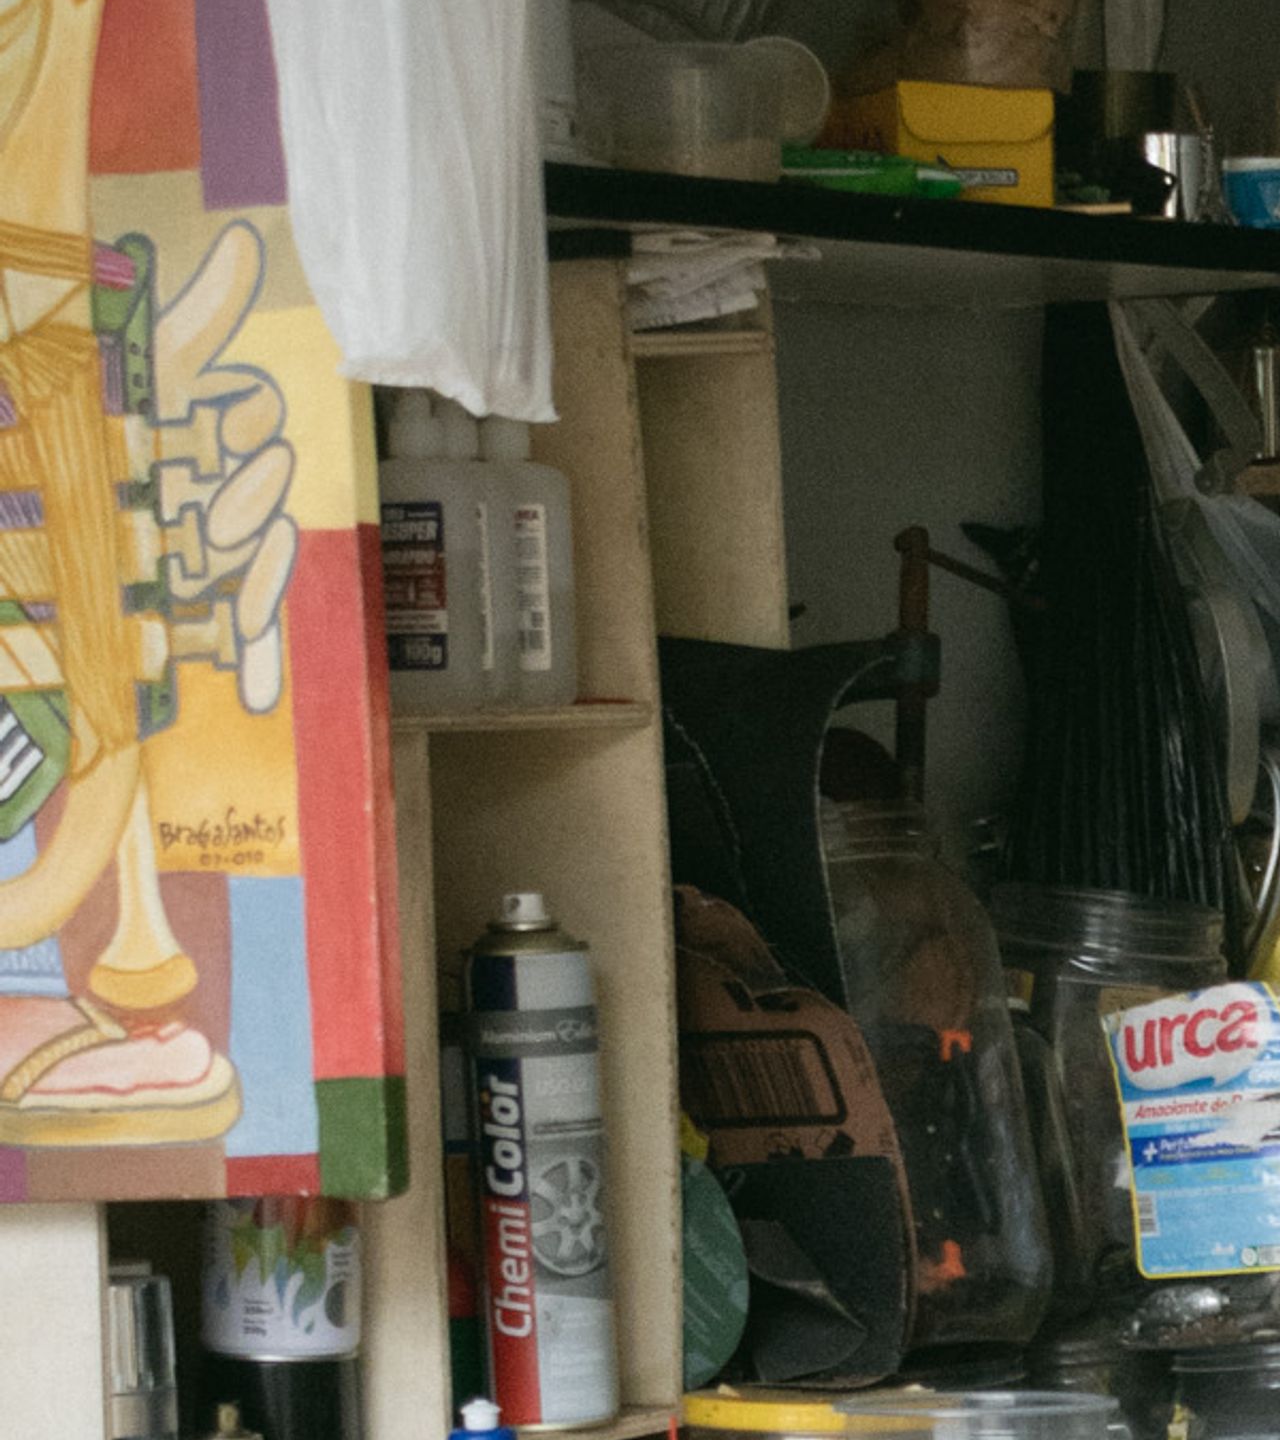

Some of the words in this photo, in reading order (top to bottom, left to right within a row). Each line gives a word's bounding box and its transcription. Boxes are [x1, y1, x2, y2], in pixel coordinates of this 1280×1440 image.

[1123, 1000, 1258, 1072] urca
[482, 1073, 524, 1197] Color
[487, 1201, 534, 1339] Chemi
